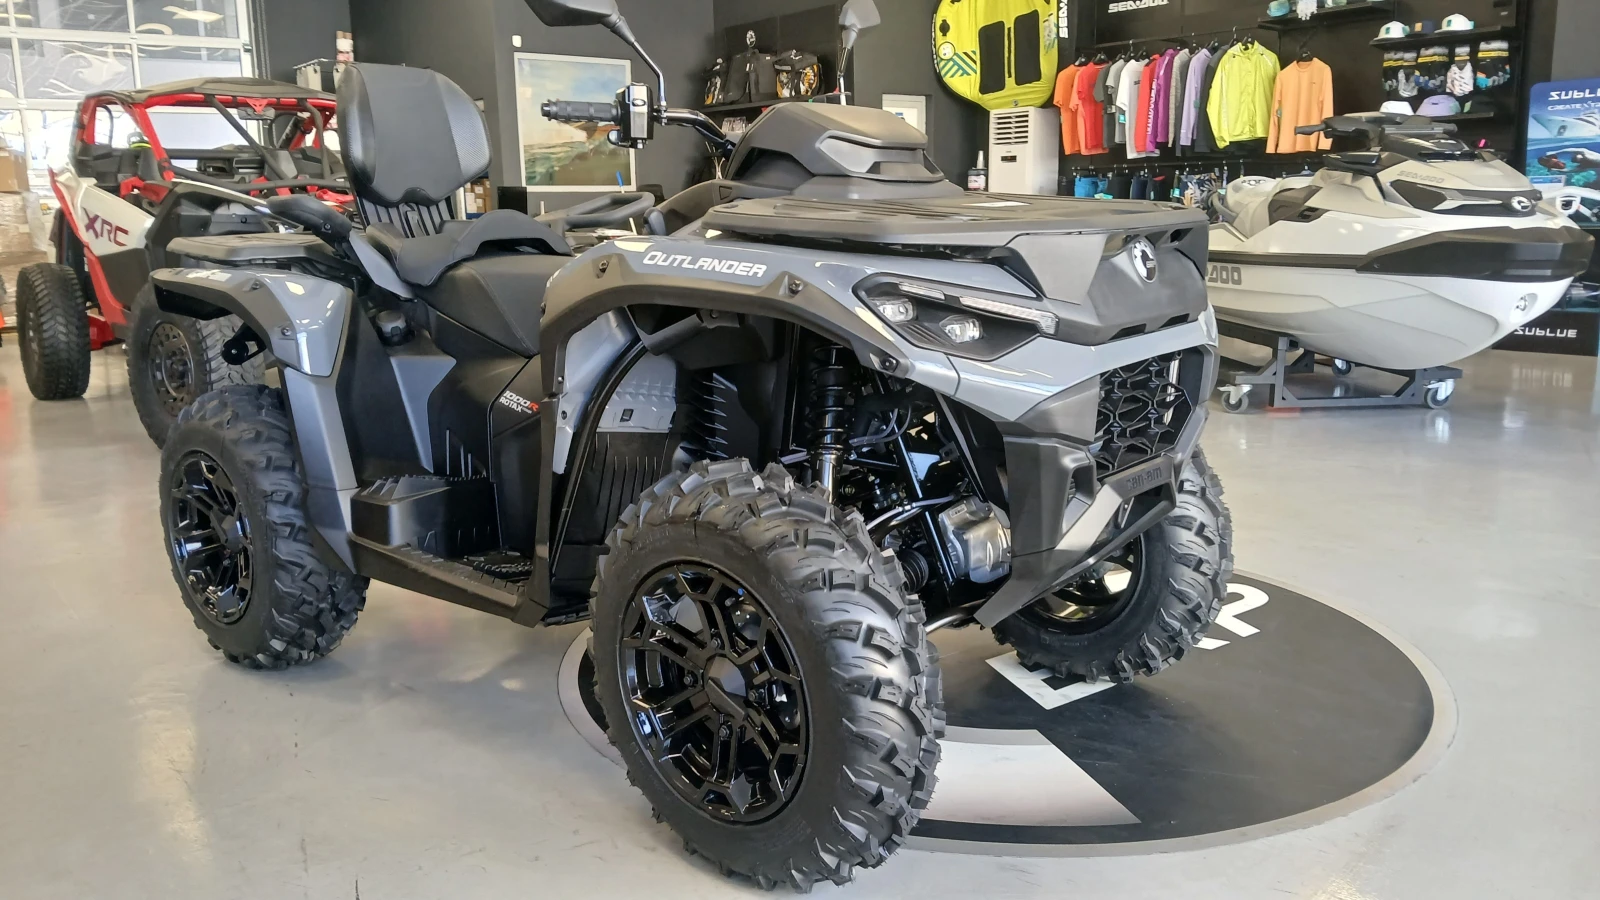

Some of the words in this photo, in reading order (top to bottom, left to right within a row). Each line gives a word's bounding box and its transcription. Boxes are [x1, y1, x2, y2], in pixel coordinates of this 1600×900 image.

[82, 206, 129, 247] XRC
[643, 251, 767, 277] OUTLANDER
[1206, 265, 1242, 285] DOO
[1514, 327, 1578, 338] SUBLUE
[499, 396, 523, 413] ROTAX
[503, 390, 540, 412] 1000R
[1126, 467, 1162, 491] can-am
